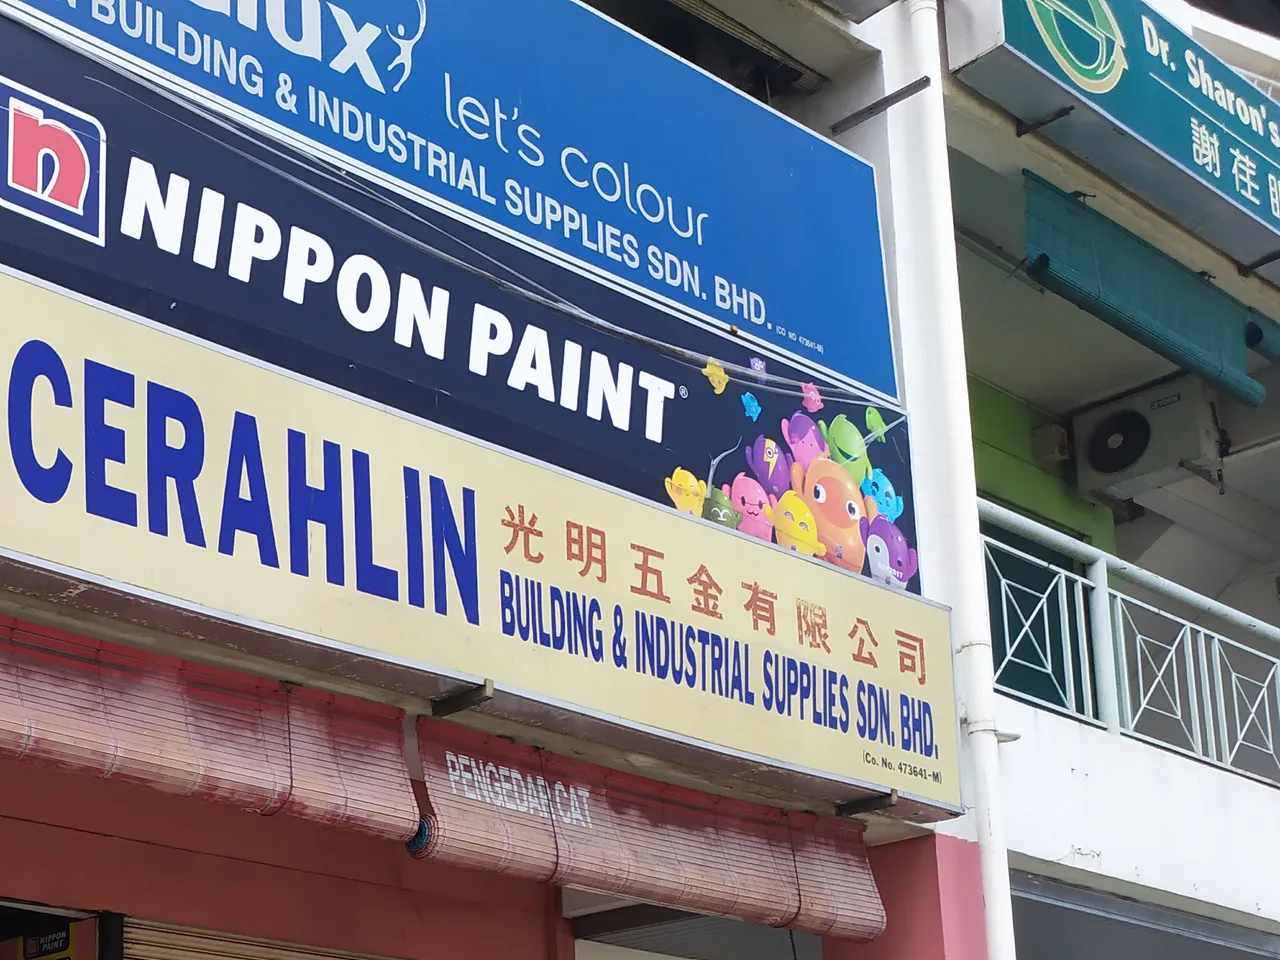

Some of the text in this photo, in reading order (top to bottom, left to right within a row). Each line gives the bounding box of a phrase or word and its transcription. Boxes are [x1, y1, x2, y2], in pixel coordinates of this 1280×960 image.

[91, 0, 264, 98] BUILDING
[275, 72, 298, 114] &
[308, 85, 497, 206] INDUSTRIAL
[504, 179, 639, 271] SUPPLIES
[647, 245, 707, 301] SDN.
[714, 275, 772, 330] BHD.
[444, 73, 709, 246] let's colour
[1141, 15, 1280, 148] Dr. Sharon's
[120, 156, 675, 443] NIPPON PAINT
[8, 339, 480, 626] CERAHLIN
[499, 569, 939, 760] BUILDING & INDUSTRIAL SUPPLIES SDN. BHD.
[501, 504, 926, 686] 光明五金有限公司
[445, 750, 592, 828] PENGEDAR CAT
[862, 750, 942, 784] (Co. No. 473641-M)
[40, 930, 66, 944] NIPPON
[42, 939, 64, 952] PAINT
